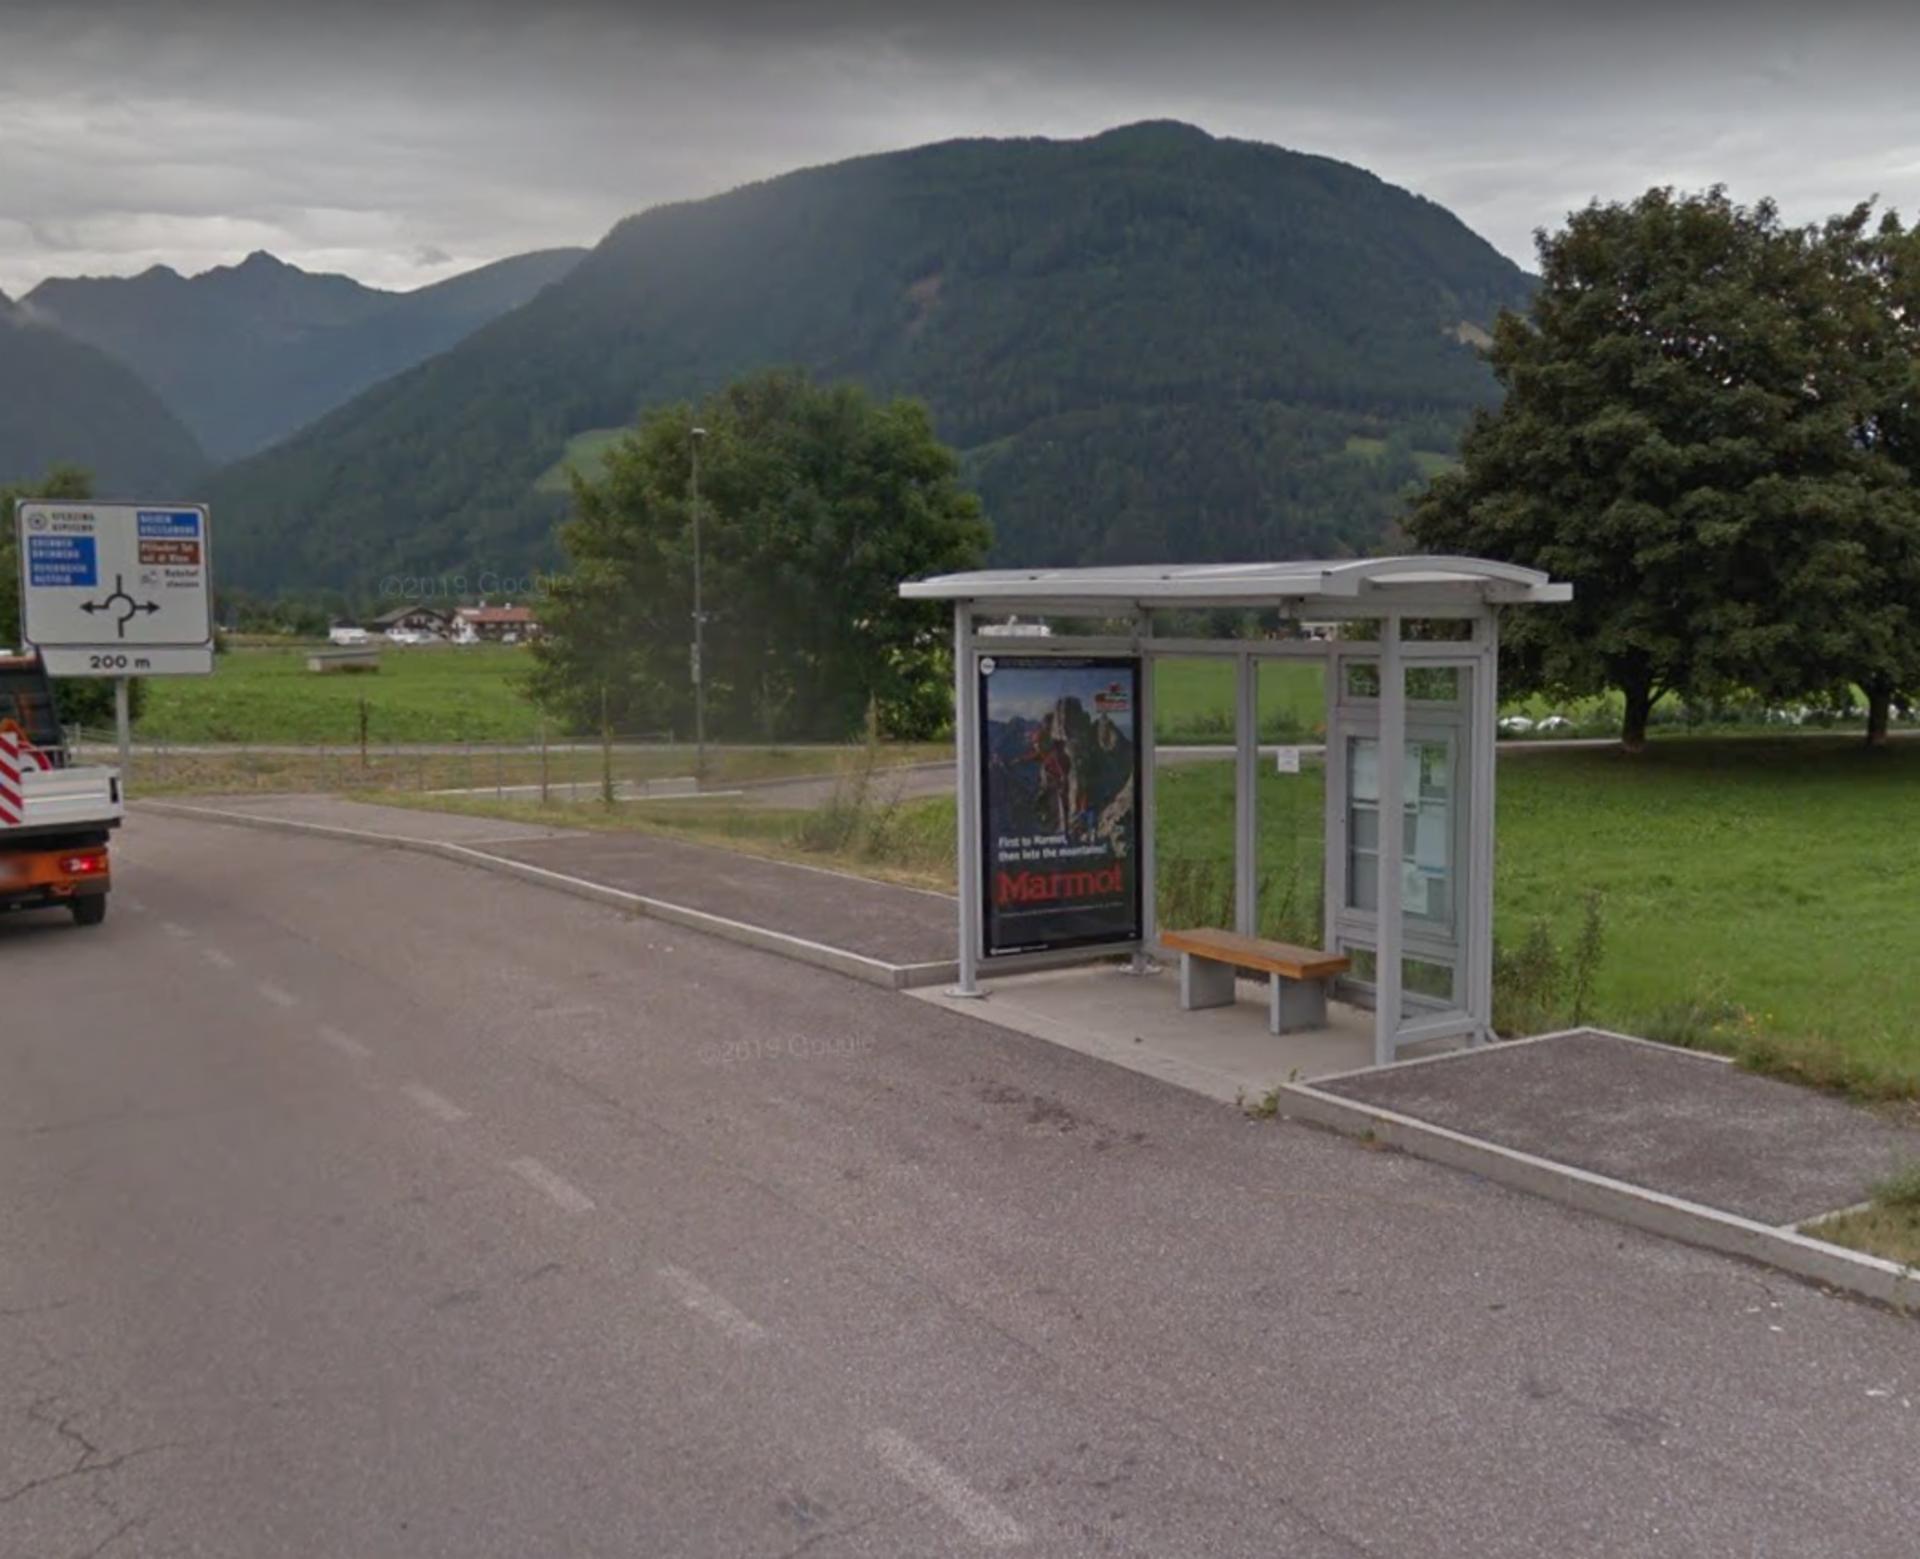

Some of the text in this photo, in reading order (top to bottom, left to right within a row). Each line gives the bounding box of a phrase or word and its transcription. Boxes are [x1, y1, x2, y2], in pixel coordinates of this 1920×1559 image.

[90, 654, 151, 669] 200 m
[1021, 837, 1031, 847] to
[1042, 848, 1057, 858] the
